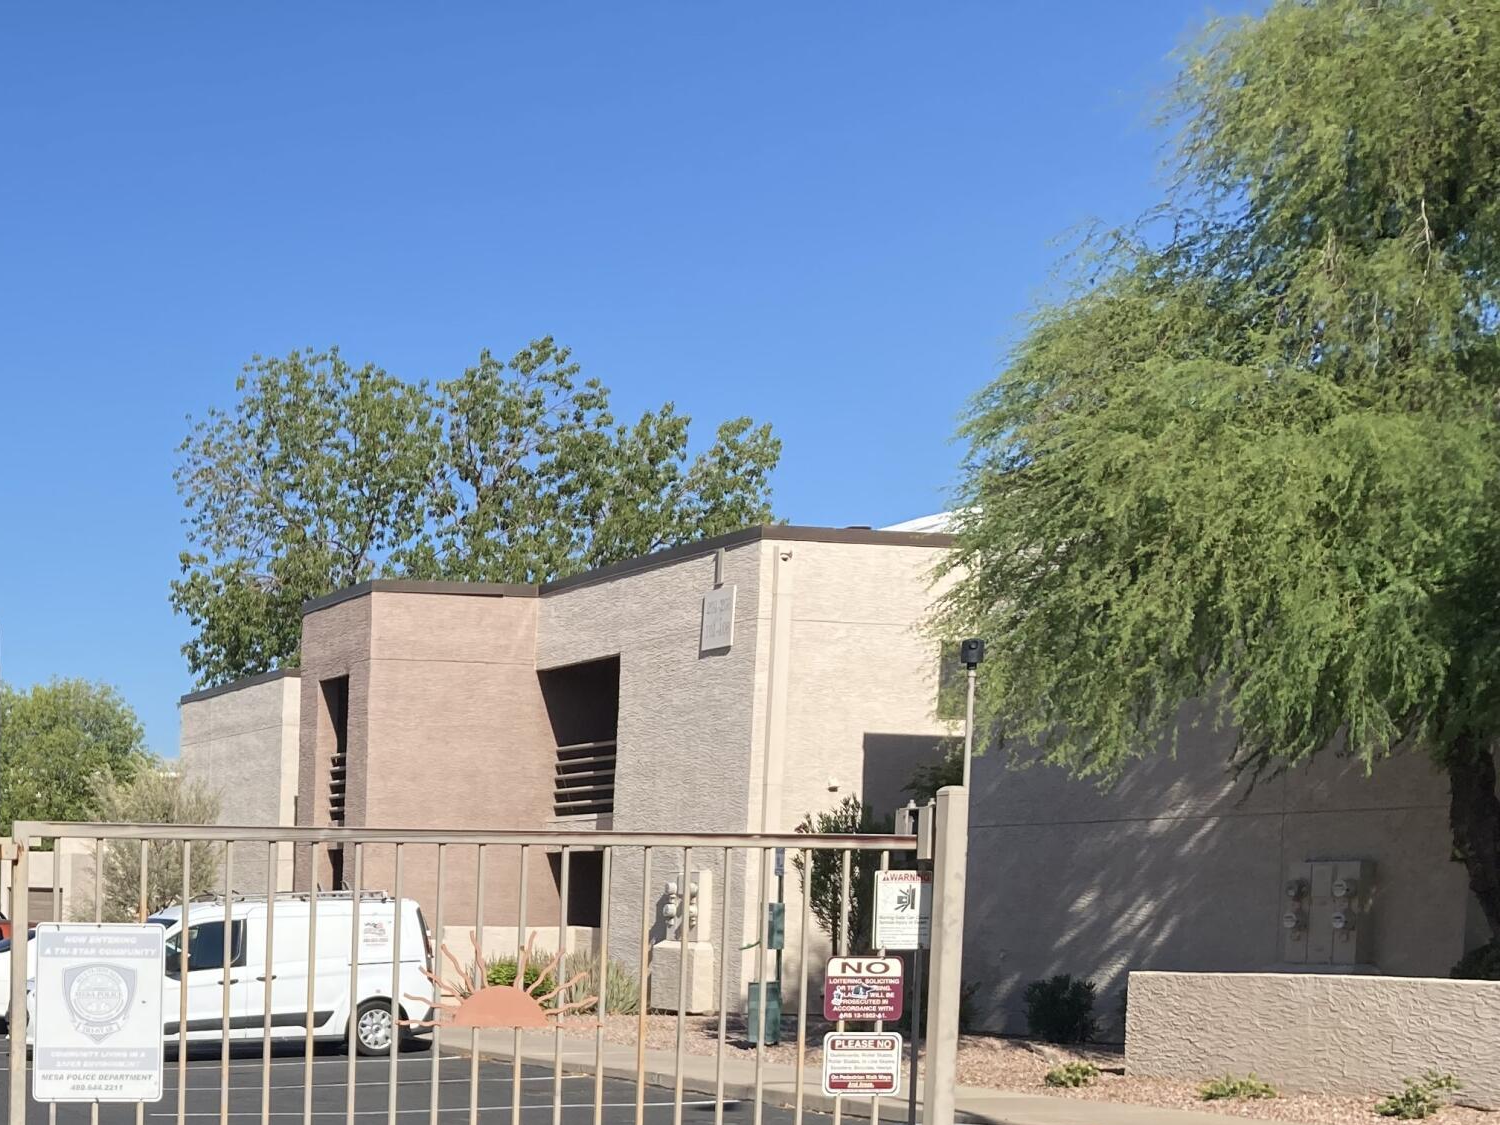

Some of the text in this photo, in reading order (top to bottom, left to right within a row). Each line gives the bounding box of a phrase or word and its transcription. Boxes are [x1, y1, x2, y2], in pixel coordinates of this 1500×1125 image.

[840, 961, 890, 975] NO
[835, 1039, 892, 1048] PLEASE NO
